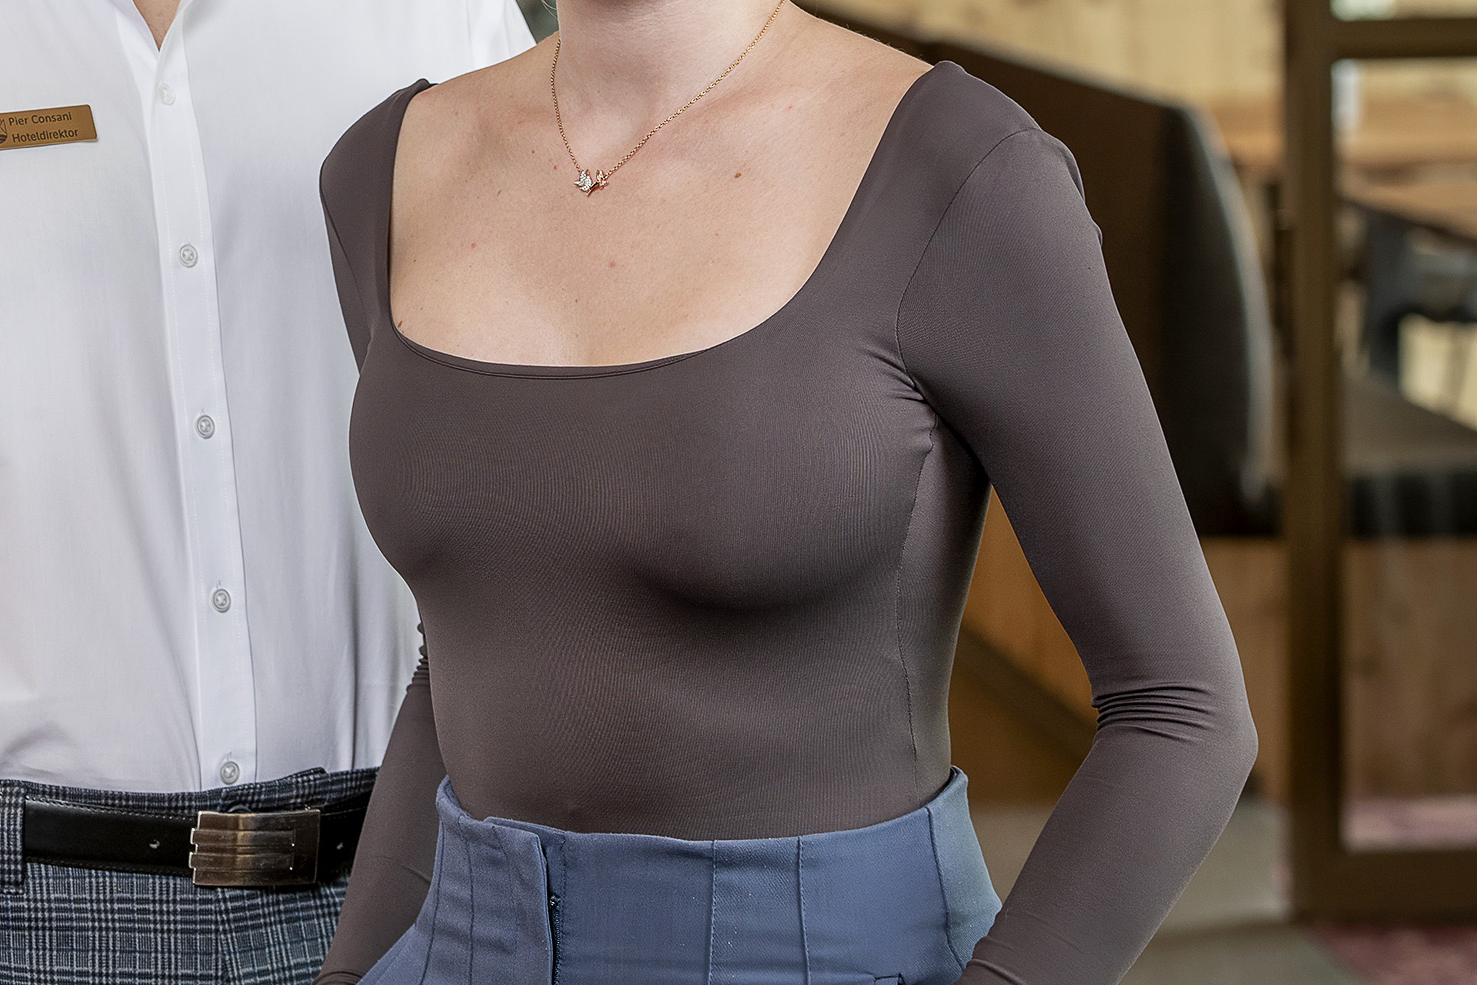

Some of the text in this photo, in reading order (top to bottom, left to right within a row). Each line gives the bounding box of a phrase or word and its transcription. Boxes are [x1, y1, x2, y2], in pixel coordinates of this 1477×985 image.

[8, 111, 72, 126] Pier Consani
[11, 129, 78, 143] Hoteldirektor
